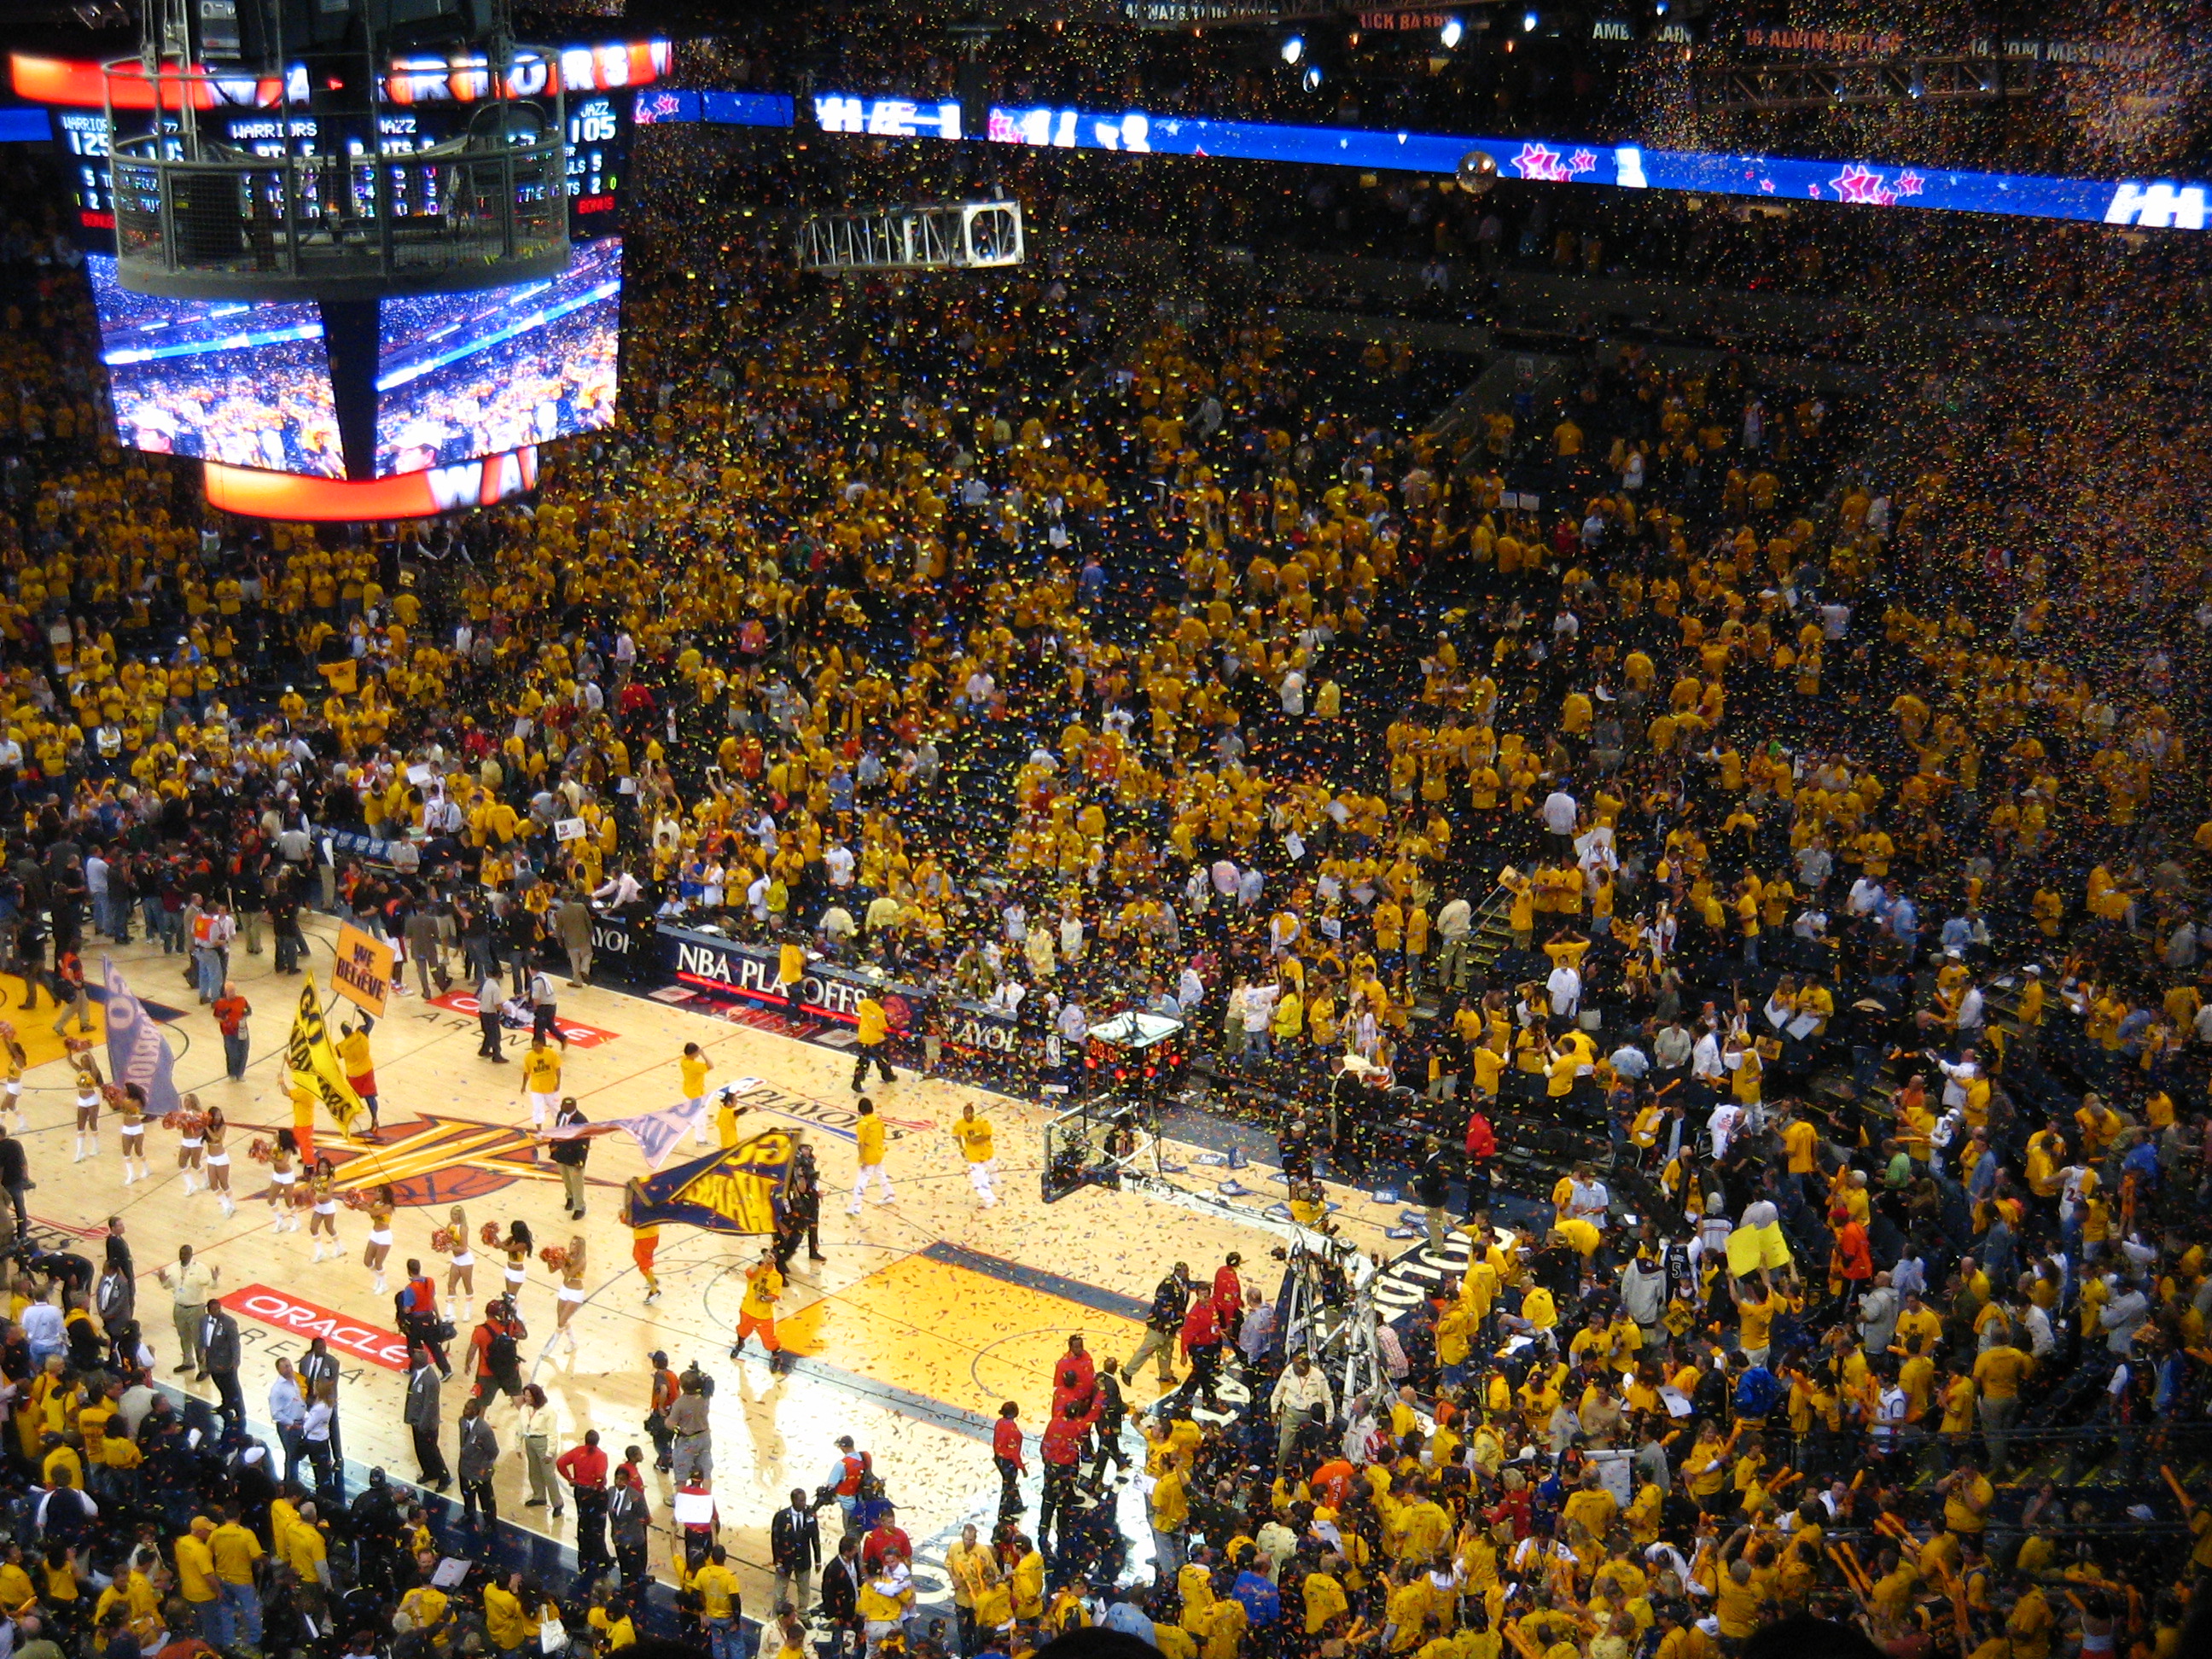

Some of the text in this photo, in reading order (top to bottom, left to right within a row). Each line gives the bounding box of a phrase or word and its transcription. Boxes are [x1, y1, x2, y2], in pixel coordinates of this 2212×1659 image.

[580, 101, 609, 118] JAZZ
[571, 115, 616, 144] 105
[70, 131, 110, 158] 125
[592, 154, 602, 172] 5
[85, 169, 96, 187] 5
[591, 176, 601, 195] 2
[90, 194, 100, 210] 2
[353, 942, 375, 972] WE
[677, 942, 869, 1017] NBA PLAOFFS
[1671, 1262, 1682, 1279] 5
[244, 1295, 410, 1364] ORACLE
